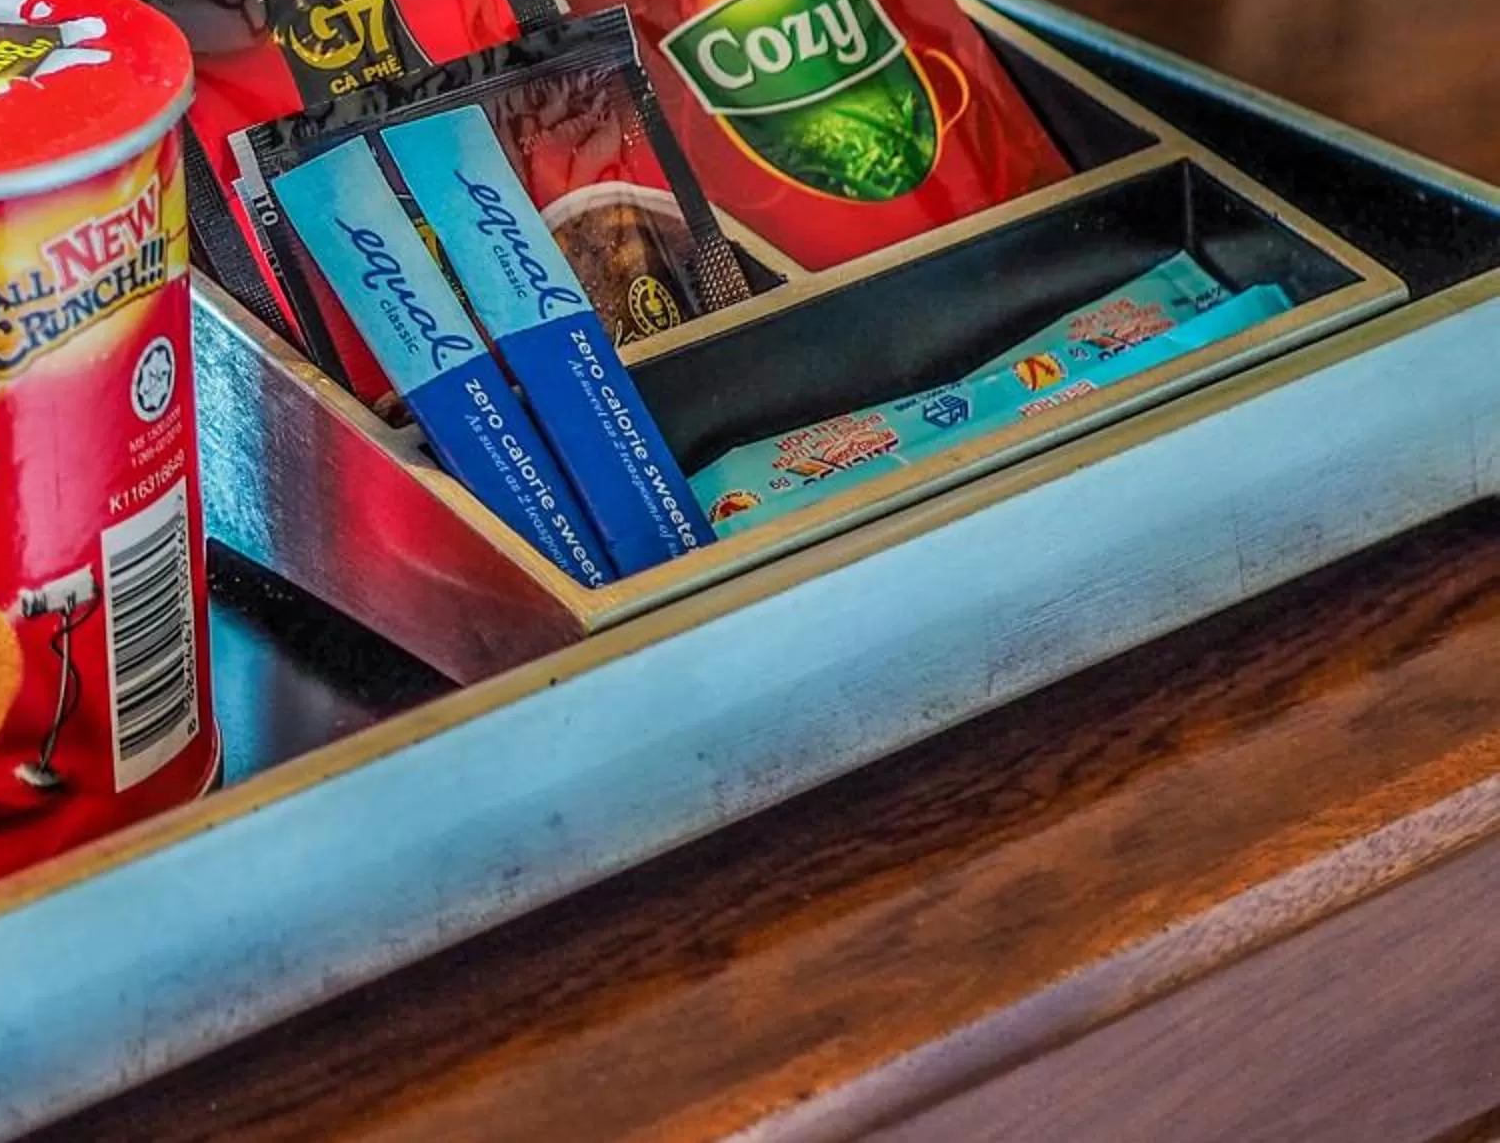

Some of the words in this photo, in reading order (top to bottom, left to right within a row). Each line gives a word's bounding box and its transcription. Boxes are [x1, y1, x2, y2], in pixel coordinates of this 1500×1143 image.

[46, 180, 159, 294] NEW
[334, 216, 474, 370] equal
[453, 169, 583, 320] equal
[492, 243, 528, 299] classic
[379, 298, 421, 355] classic
[464, 377, 504, 431] zero
[500, 432, 556, 511] calorie
[464, 412, 484, 433] As
[478, 432, 508, 474] sweet
[503, 474, 523, 495] as
[567, 357, 585, 379] As
[579, 377, 608, 418] sweet
[602, 418, 618, 438] as
[570, 328, 605, 381] zero
[600, 384, 649, 461] calorie
[643, 463, 700, 550] sweete
